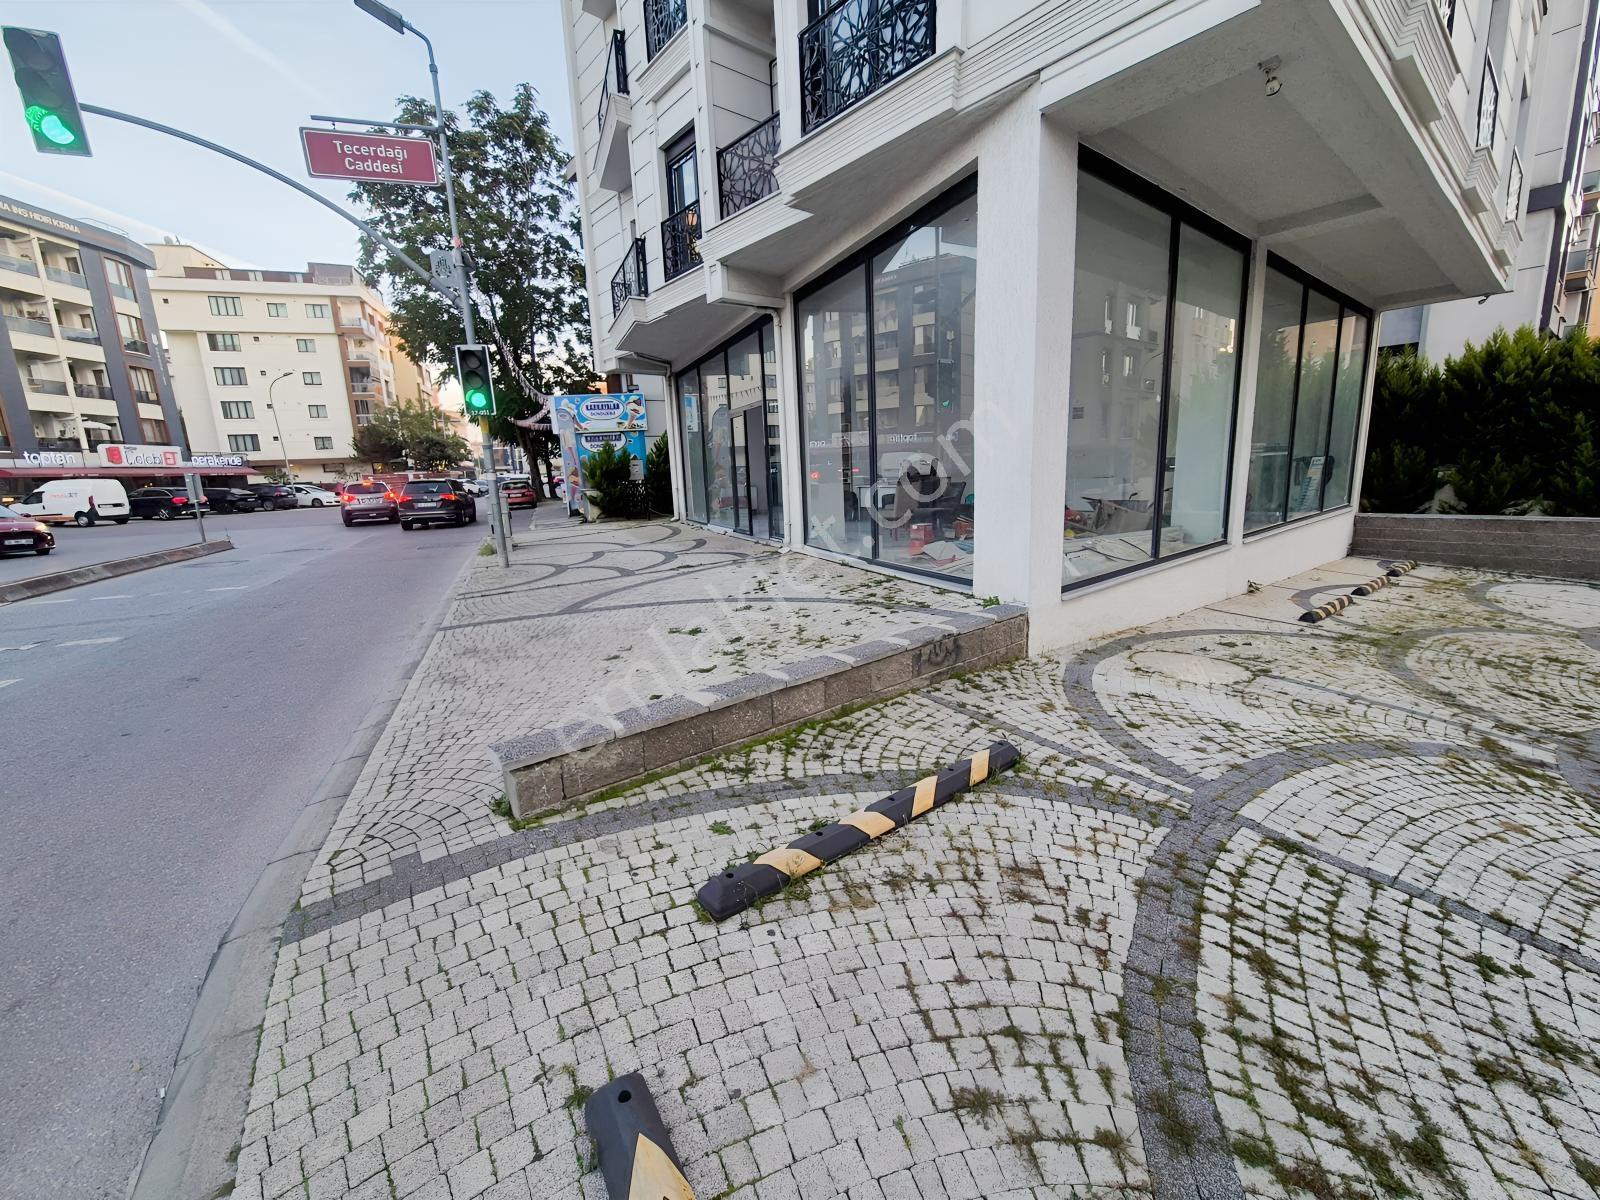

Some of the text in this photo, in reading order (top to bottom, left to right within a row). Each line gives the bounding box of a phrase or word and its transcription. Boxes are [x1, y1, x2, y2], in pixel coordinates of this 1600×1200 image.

[333, 140, 407, 161] Tecerdağı
[345, 158, 403, 174] Caddesi
[22, 450, 76, 466] toptan
